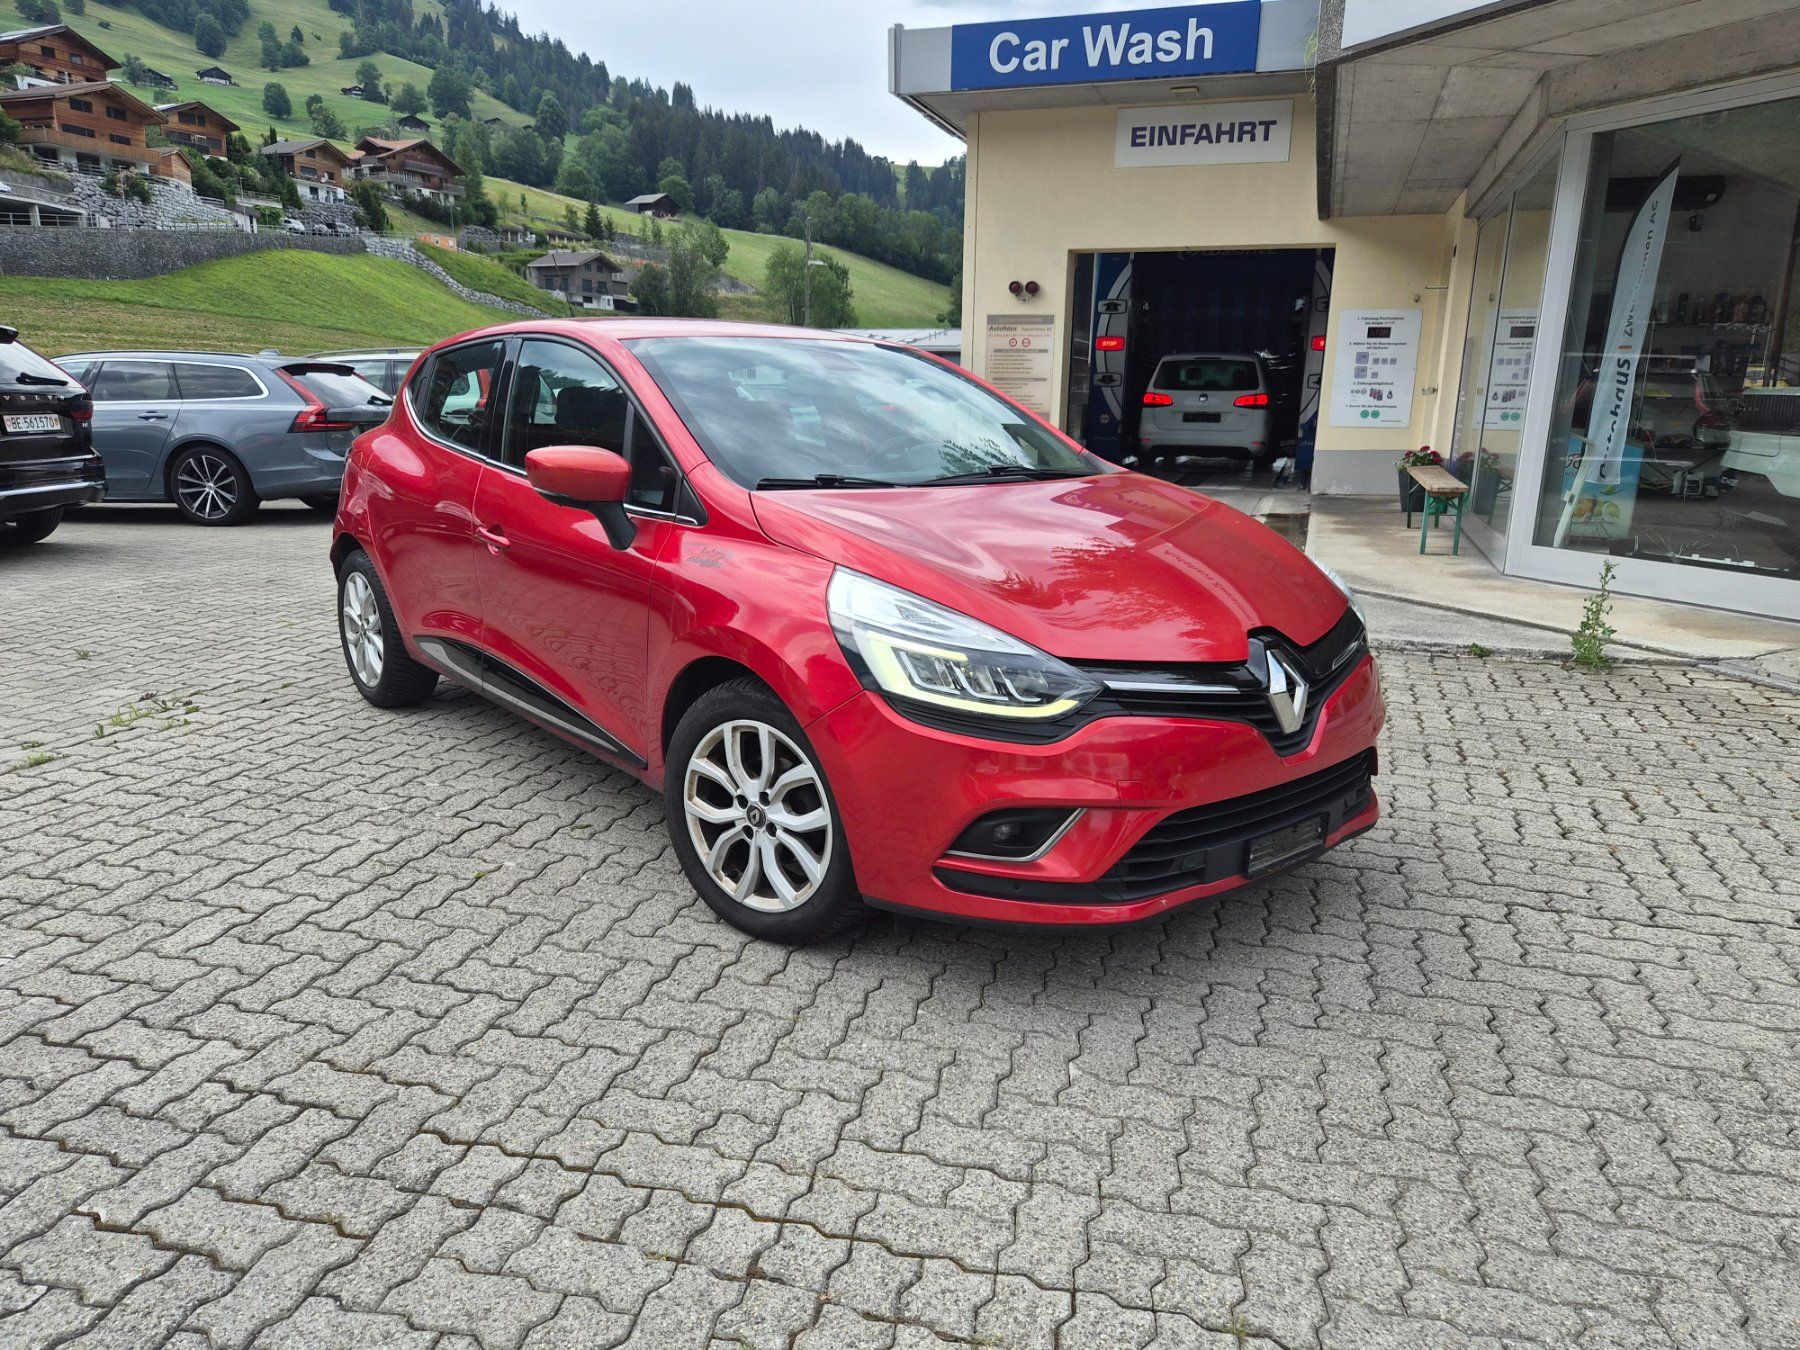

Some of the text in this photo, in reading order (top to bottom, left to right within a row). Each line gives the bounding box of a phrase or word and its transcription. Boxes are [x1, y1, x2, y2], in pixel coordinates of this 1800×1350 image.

[988, 17, 1214, 73] Car Wash
[1130, 119, 1277, 148] EINFAHRT
[11, 416, 55, 430] BE 561570
